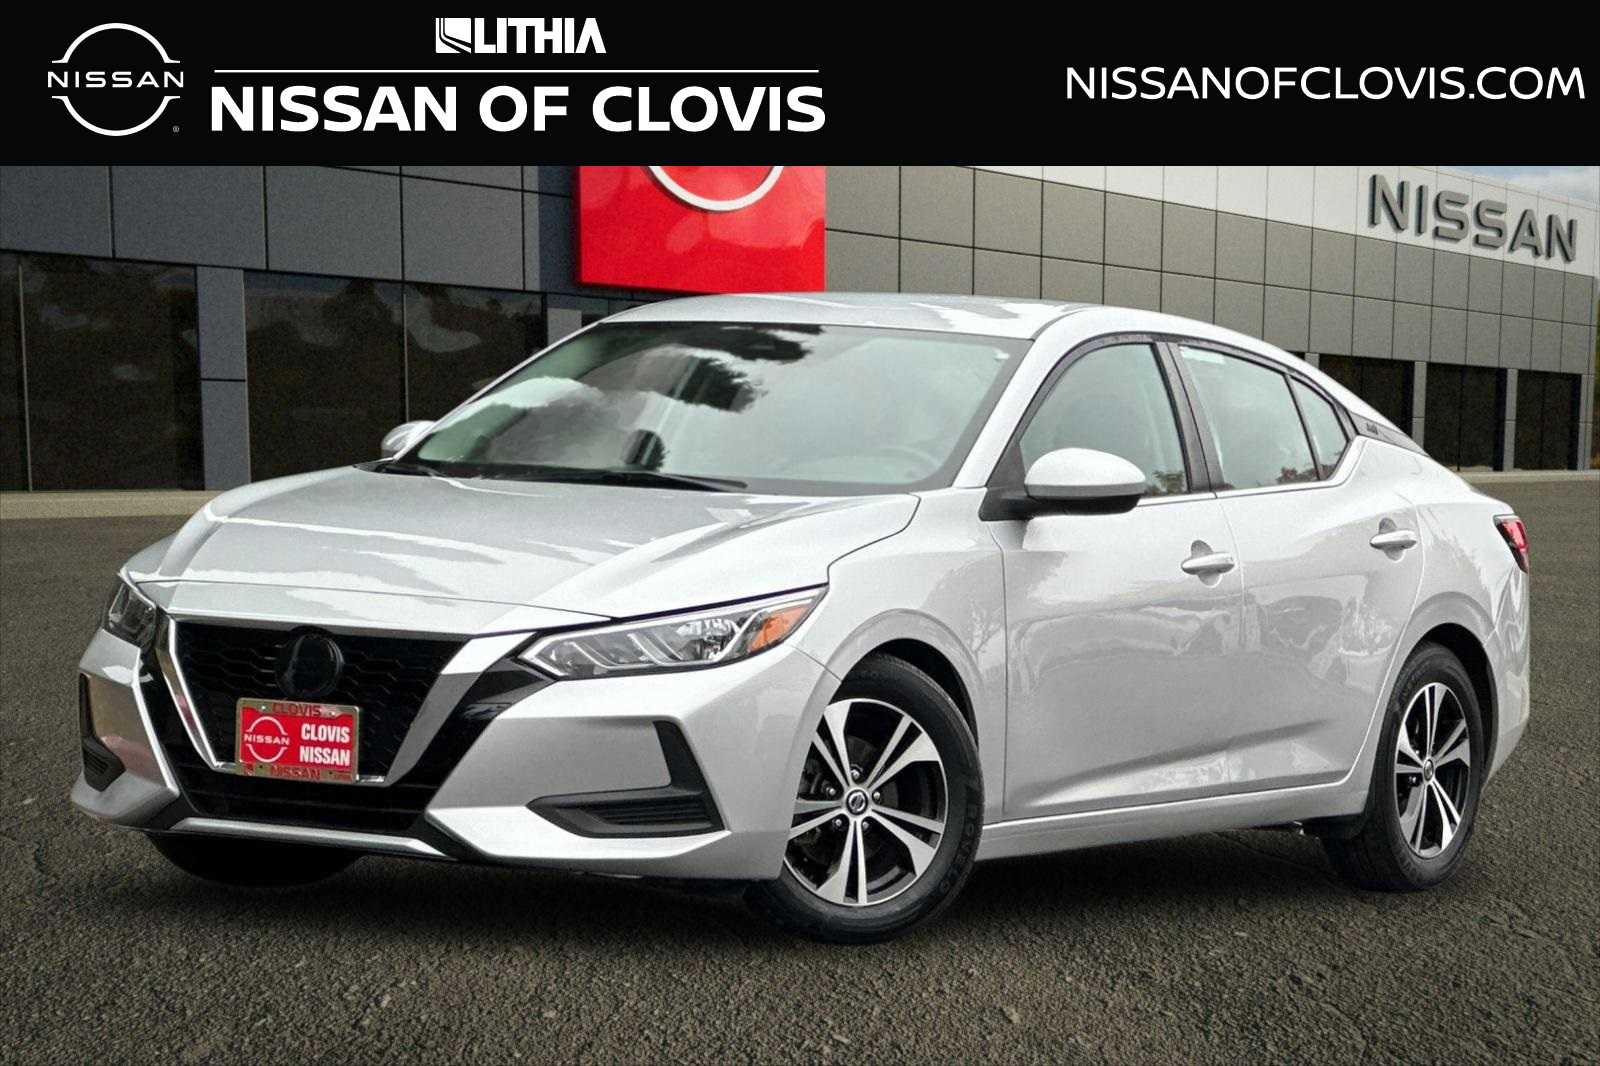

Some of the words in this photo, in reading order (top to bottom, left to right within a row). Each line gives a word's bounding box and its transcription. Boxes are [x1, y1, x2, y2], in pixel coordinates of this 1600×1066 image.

[1367, 173, 1578, 264] NISSAN
[272, 703, 322, 717] CLOVIS
[243, 733, 290, 746] NISSAN
[301, 723, 350, 743] CLOVIS
[299, 746, 350, 767] NISSAN
[270, 765, 321, 780] NISSAN
